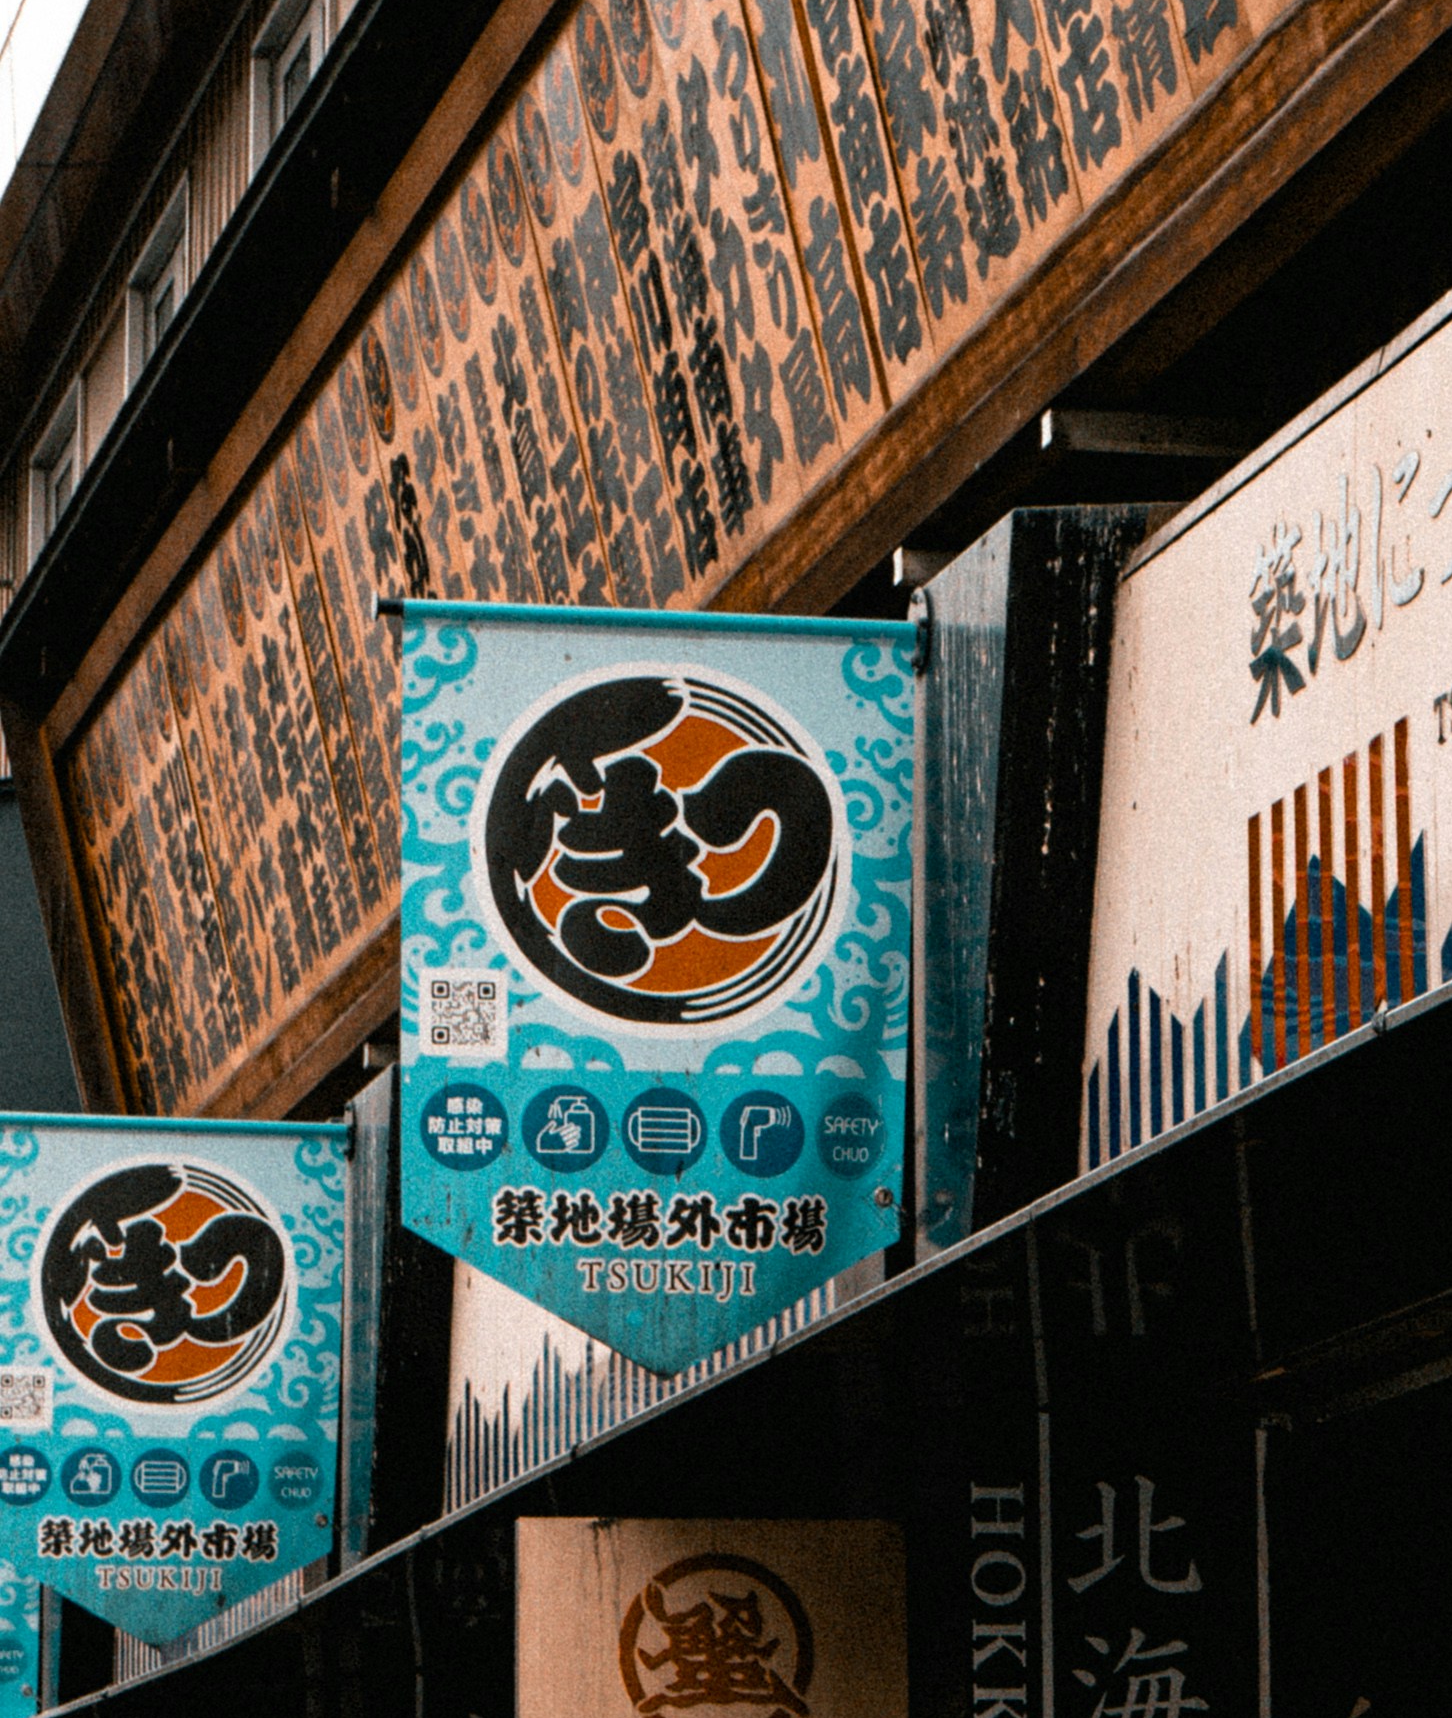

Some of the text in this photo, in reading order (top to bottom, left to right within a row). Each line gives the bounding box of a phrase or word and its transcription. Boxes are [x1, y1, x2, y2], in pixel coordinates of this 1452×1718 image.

[491, 315, 569, 603] 北島商
[446, 1095, 483, 1115] 感染
[428, 1114, 503, 1136] 防止対策
[823, 1113, 880, 1139] SAFETY
[437, 1134, 493, 1157] 取組中
[832, 1144, 869, 1164] CHUO
[491, 1185, 828, 1255] 築地場外市場
[578, 1258, 756, 1298] TSUKIJI
[273, 1462, 319, 1482] SAFETY
[39, 1517, 279, 1562] 築地場外市場
[95, 1564, 224, 1594] TSUKIJI
